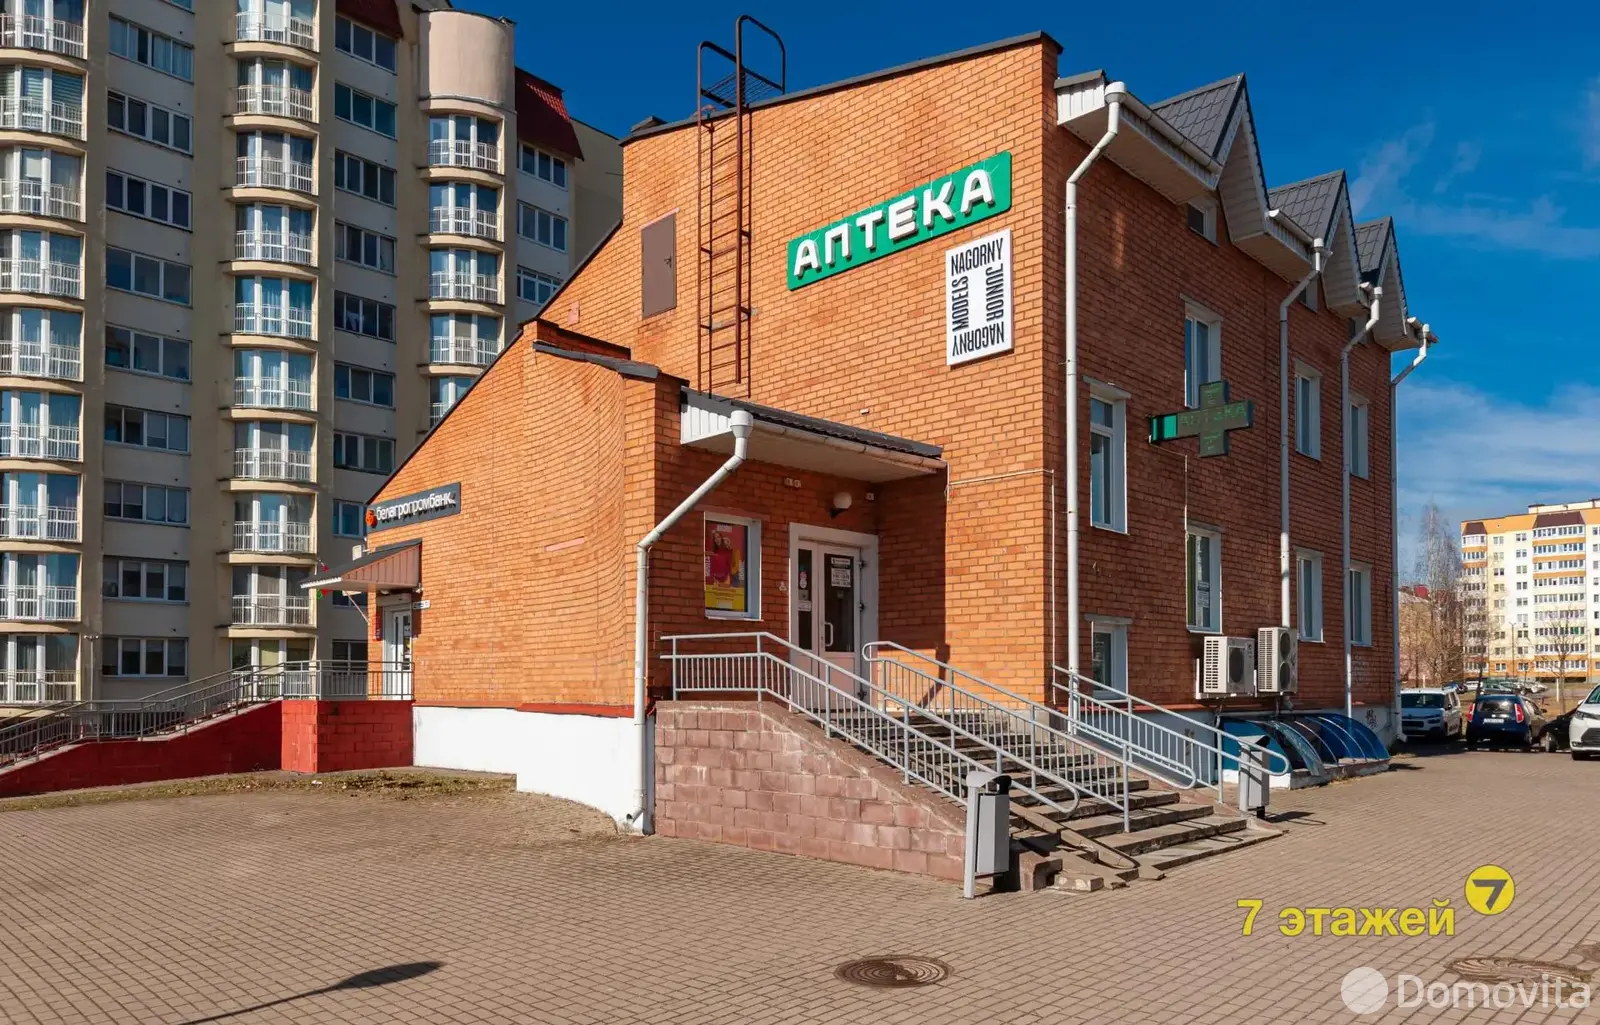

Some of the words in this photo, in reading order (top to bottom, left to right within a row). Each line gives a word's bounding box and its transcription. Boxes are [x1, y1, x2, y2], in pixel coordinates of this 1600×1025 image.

[793, 168, 994, 279] АПТЕКА
[951, 237, 1004, 277] NAGORNY
[951, 275, 970, 332] MODELS
[985, 263, 1005, 322] JUNIOR
[952, 321, 1005, 357] NAGORNY
[376, 492, 456, 521] белагропромбанк
